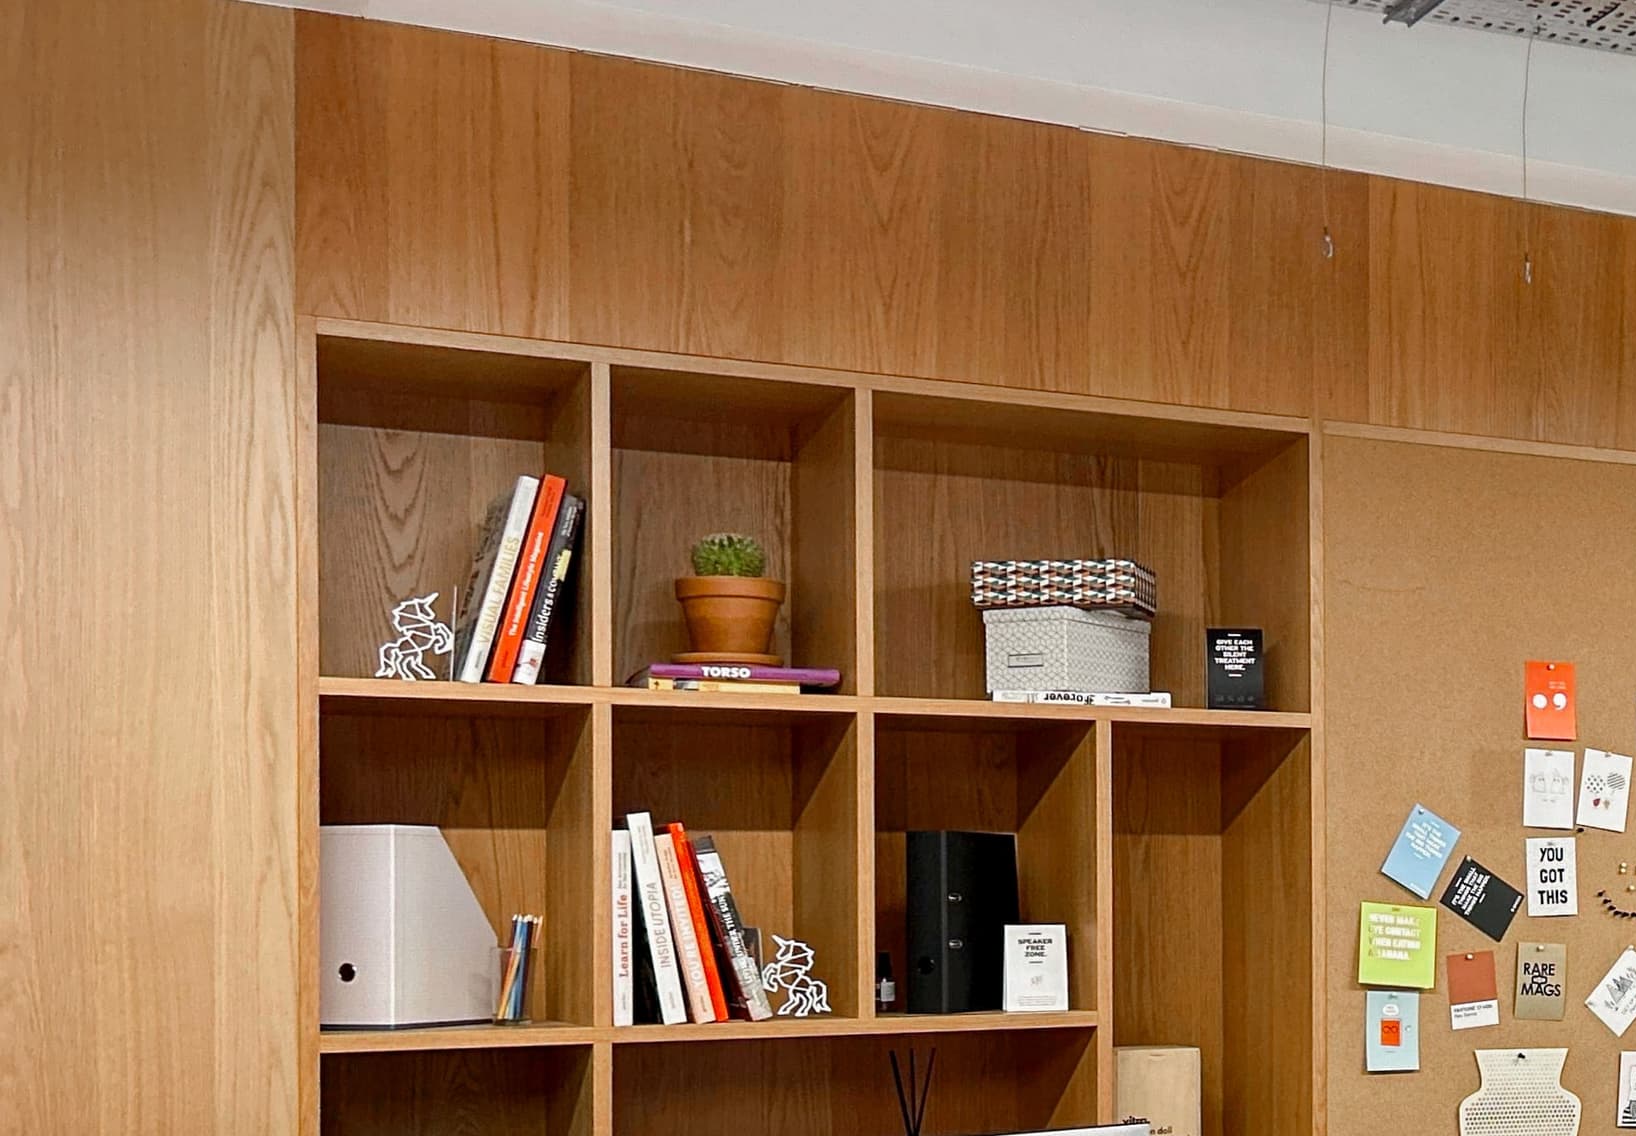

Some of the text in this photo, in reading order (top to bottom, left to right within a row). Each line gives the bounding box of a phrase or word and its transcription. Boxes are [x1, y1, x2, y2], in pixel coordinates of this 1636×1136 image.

[477, 596, 502, 645] VISUAL
[492, 534, 519, 596] FAMILIES
[701, 666, 751, 678] TORSO
[1044, 692, 1096, 705] Forever
[1539, 847, 1564, 862] YOU
[1539, 868, 1565, 884] GOT
[645, 881, 664, 926] UTOPIA
[1537, 889, 1568, 905] THIS
[616, 893, 627, 918] Life
[617, 920, 628, 938] for
[653, 928, 672, 968] INSIDE
[618, 941, 629, 977] Learn
[1523, 962, 1556, 976] RARE
[1521, 983, 1561, 997] MAGS
[1157, 1126, 1173, 1135] doll
